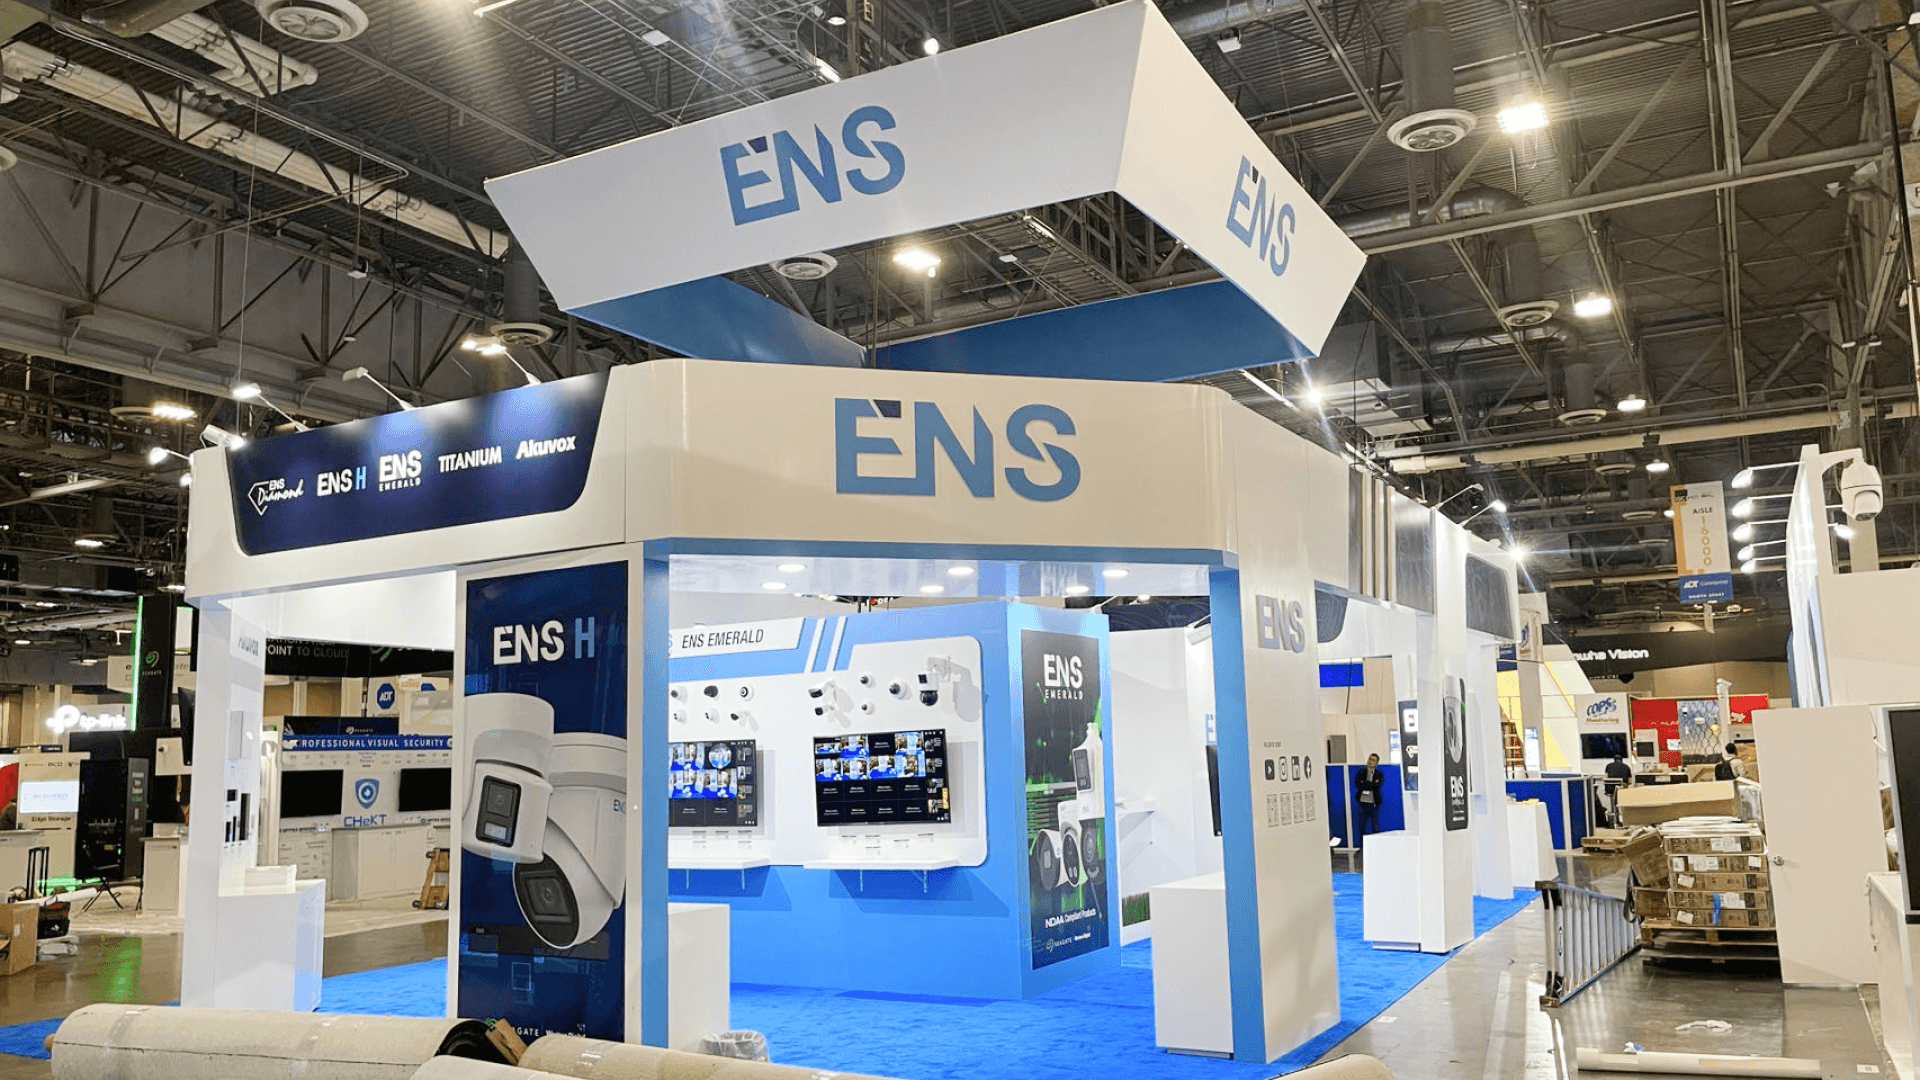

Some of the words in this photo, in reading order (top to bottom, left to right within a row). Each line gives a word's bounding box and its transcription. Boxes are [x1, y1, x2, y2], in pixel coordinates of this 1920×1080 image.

[720, 105, 905, 226] ENS
[1226, 154, 1296, 277] ENS
[516, 436, 576, 459] Akuvox
[834, 397, 1081, 502] ENS
[378, 450, 422, 481] ENS
[438, 446, 502, 473] TITANIUM
[257, 479, 304, 506] Diamond
[269, 478, 286, 491] ENS
[317, 469, 352, 497] ENS
[356, 466, 367, 490] H
[378, 478, 421, 492] EMERALD
[1693, 506, 1713, 515] AISLE
[1255, 594, 1305, 654] ENS
[265, 644, 293, 656] OINT
[493, 619, 565, 666] ENS
[575, 616, 595, 659] H
[682, 634, 705, 649] ENS
[708, 629, 764, 647] EMERALD
[1607, 649, 1649, 660] Vision
[1043, 654, 1083, 689] ENS
[1045, 689, 1083, 700] EMERALD
[302, 739, 366, 749] ROFESSIONAL
[368, 738, 399, 748] VISUAL
[404, 738, 444, 748] SECURITY
[1451, 775, 1464, 798] ENS
[343, 813, 387, 828] CHeKT
[1045, 915, 1064, 929] NDAA
